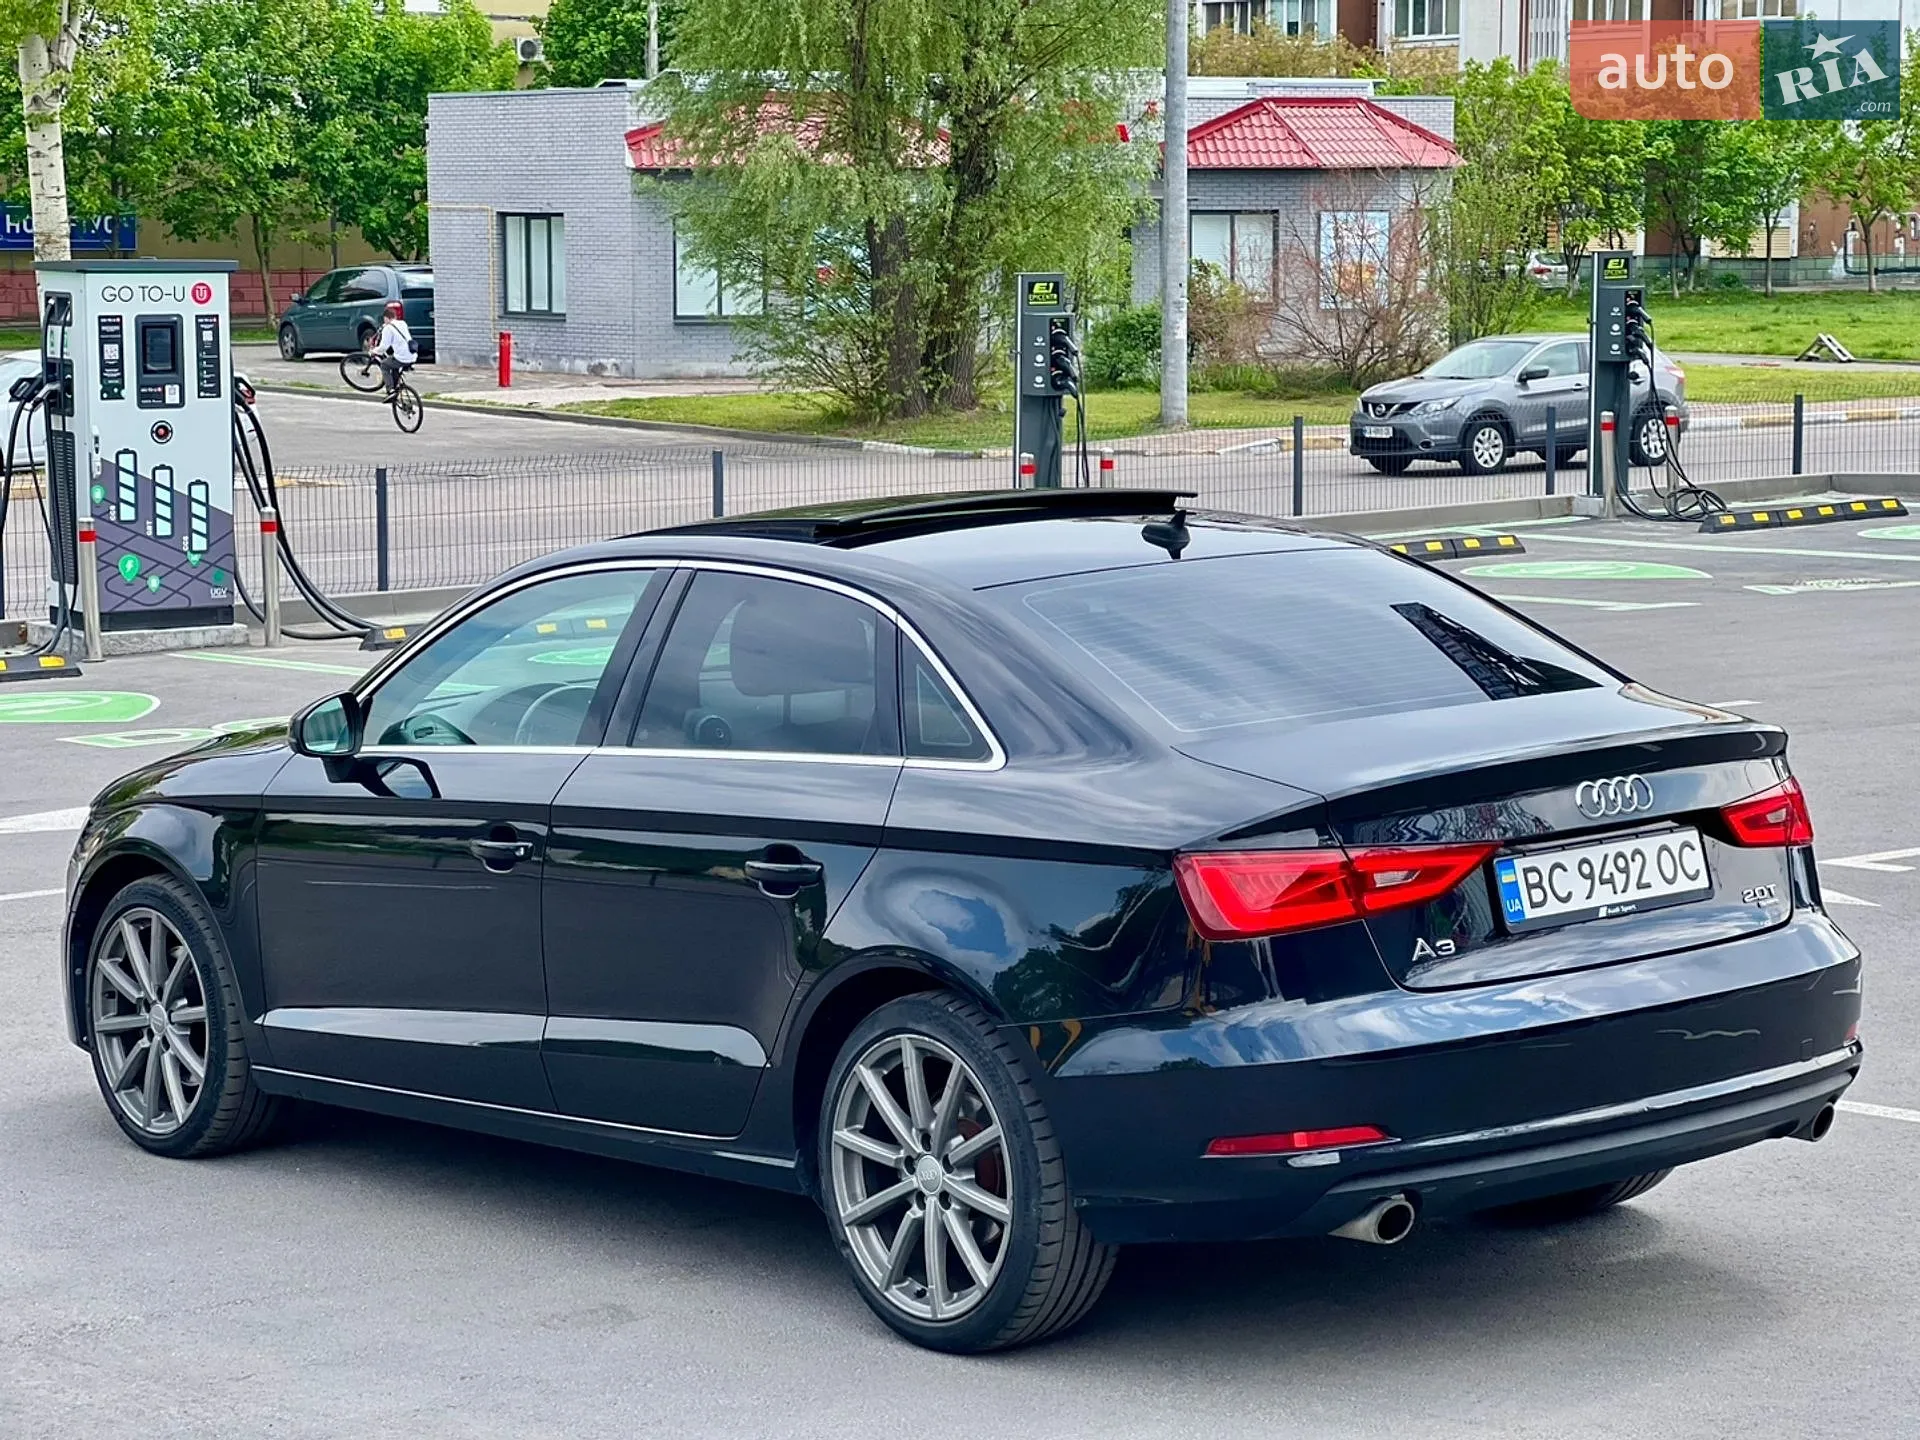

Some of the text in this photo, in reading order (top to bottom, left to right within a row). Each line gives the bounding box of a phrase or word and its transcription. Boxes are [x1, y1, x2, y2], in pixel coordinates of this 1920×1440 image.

[101, 285, 186, 303] GO TO-U
[1522, 839, 1701, 909] BC 9492 OC
[1507, 899, 1522, 912] UA
[1412, 937, 1456, 961] A3
